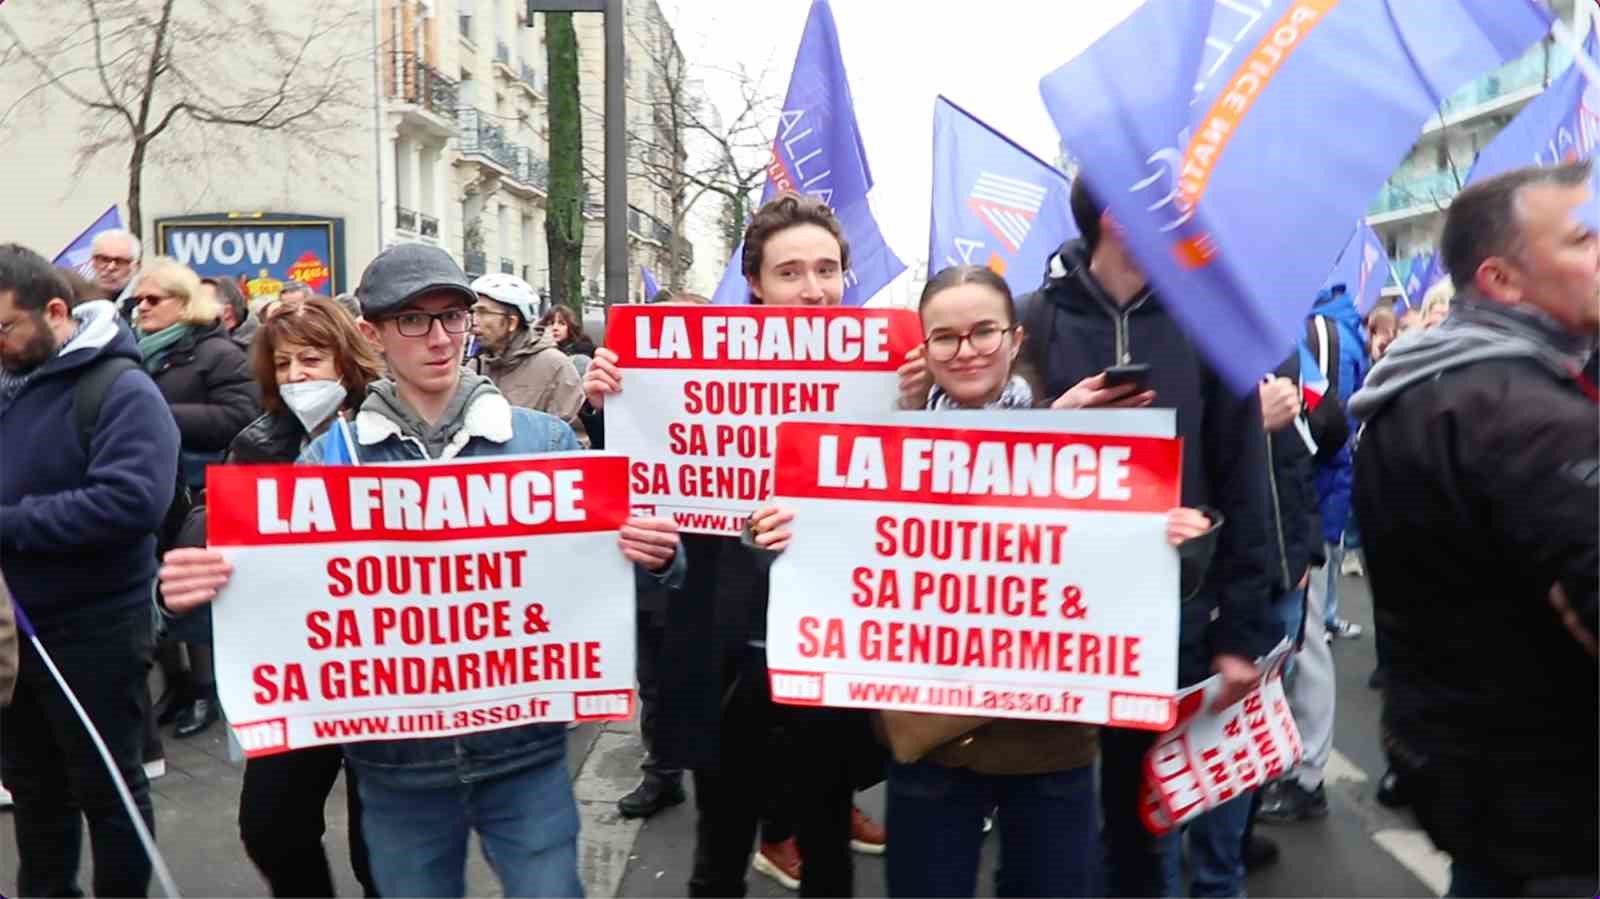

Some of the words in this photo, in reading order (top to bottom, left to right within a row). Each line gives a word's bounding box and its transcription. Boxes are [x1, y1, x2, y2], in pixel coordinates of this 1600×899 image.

[172, 231, 285, 265] WOW
[634, 315, 693, 361] LA
[701, 316, 889, 363] FRANCE
[683, 381, 840, 415] SOUTIENT
[668, 423, 708, 457] SA
[716, 425, 772, 459] POL
[631, 462, 670, 496] SA
[678, 464, 770, 501] GENDA
[817, 434, 888, 491] LA
[901, 437, 1132, 501] FRANCE
[257, 477, 336, 535] LA
[350, 468, 586, 532] FRANCE
[874, 516, 1068, 565] SOUTIENT
[326, 550, 527, 598] SOUTIENT
[851, 567, 900, 609] SA
[913, 571, 1048, 618] POLICE
[1060, 585, 1087, 620] &
[305, 610, 361, 651] SA
[374, 600, 511, 646] POLICE
[523, 602, 550, 635] &
[797, 615, 846, 659] SA
[858, 619, 1142, 679] GENDARMERIE
[252, 663, 308, 706] SA
[320, 641, 602, 700] GENDARMERIE
[848, 678, 1084, 716] www.uni.asso.fr
[313, 697, 551, 739] www.uni.asso.fr
